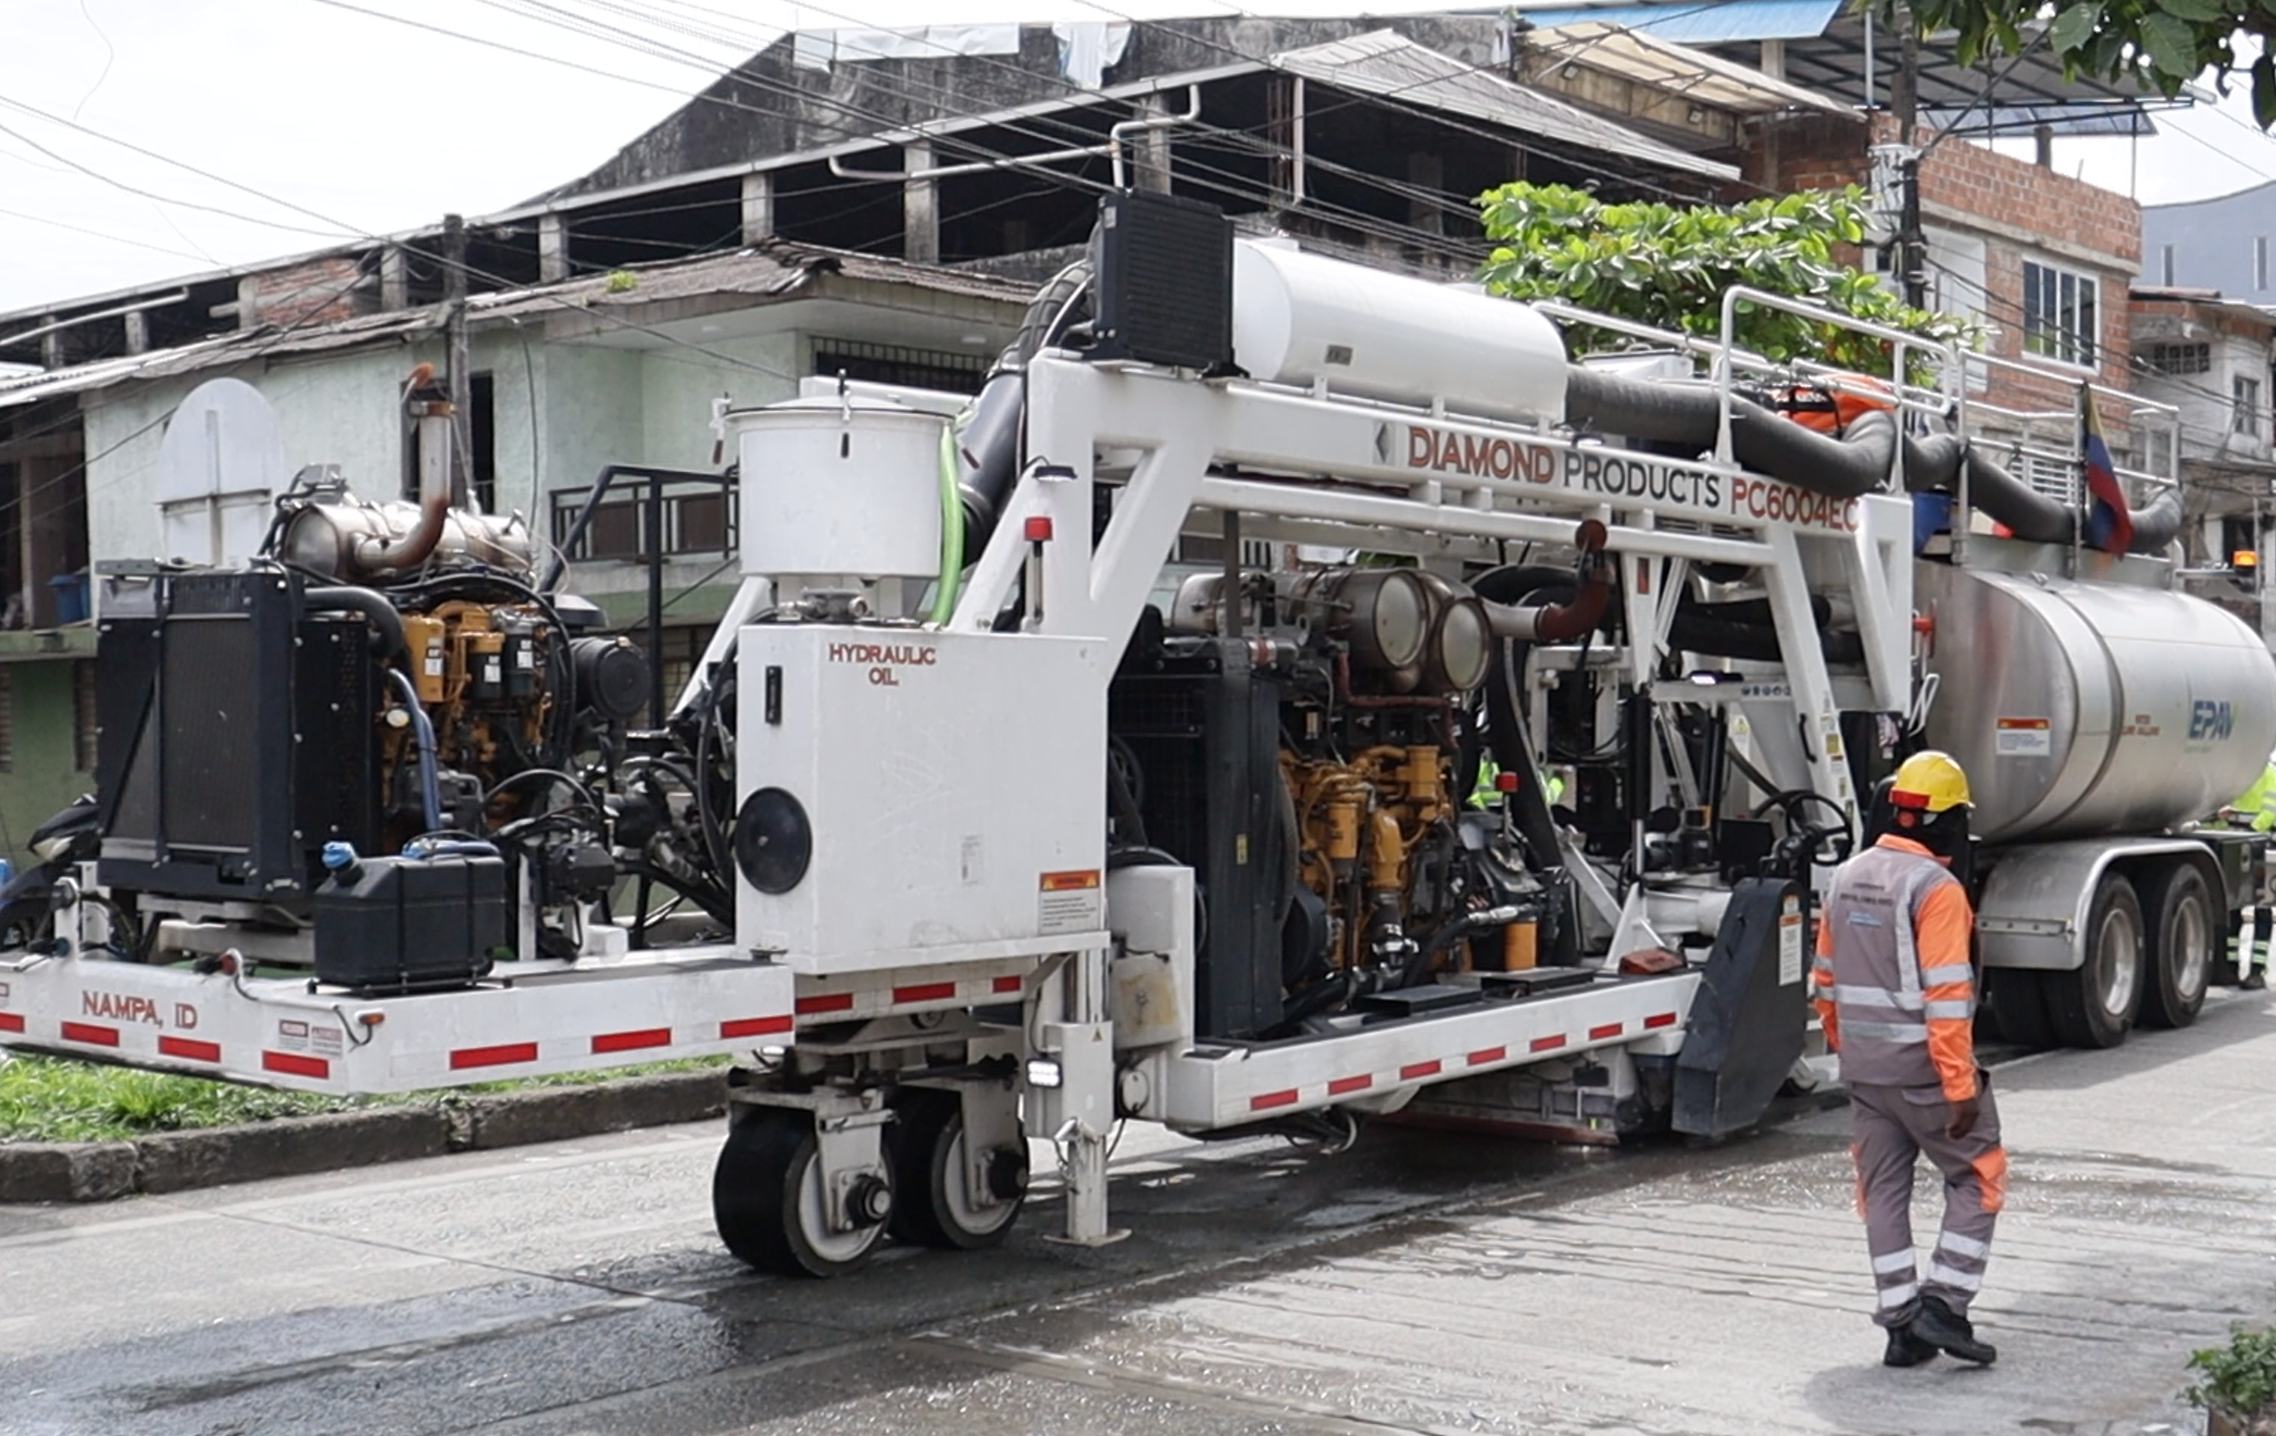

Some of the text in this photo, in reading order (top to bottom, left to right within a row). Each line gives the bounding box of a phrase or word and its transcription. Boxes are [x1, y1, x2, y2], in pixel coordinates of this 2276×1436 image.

[1408, 426, 1859, 532] DIAMOND PRODUCTS PC6004EC
[828, 643, 937, 666] HYDRAULIC
[868, 666, 899, 686] OIL
[81, 989, 198, 1029] NAMPA, ID
